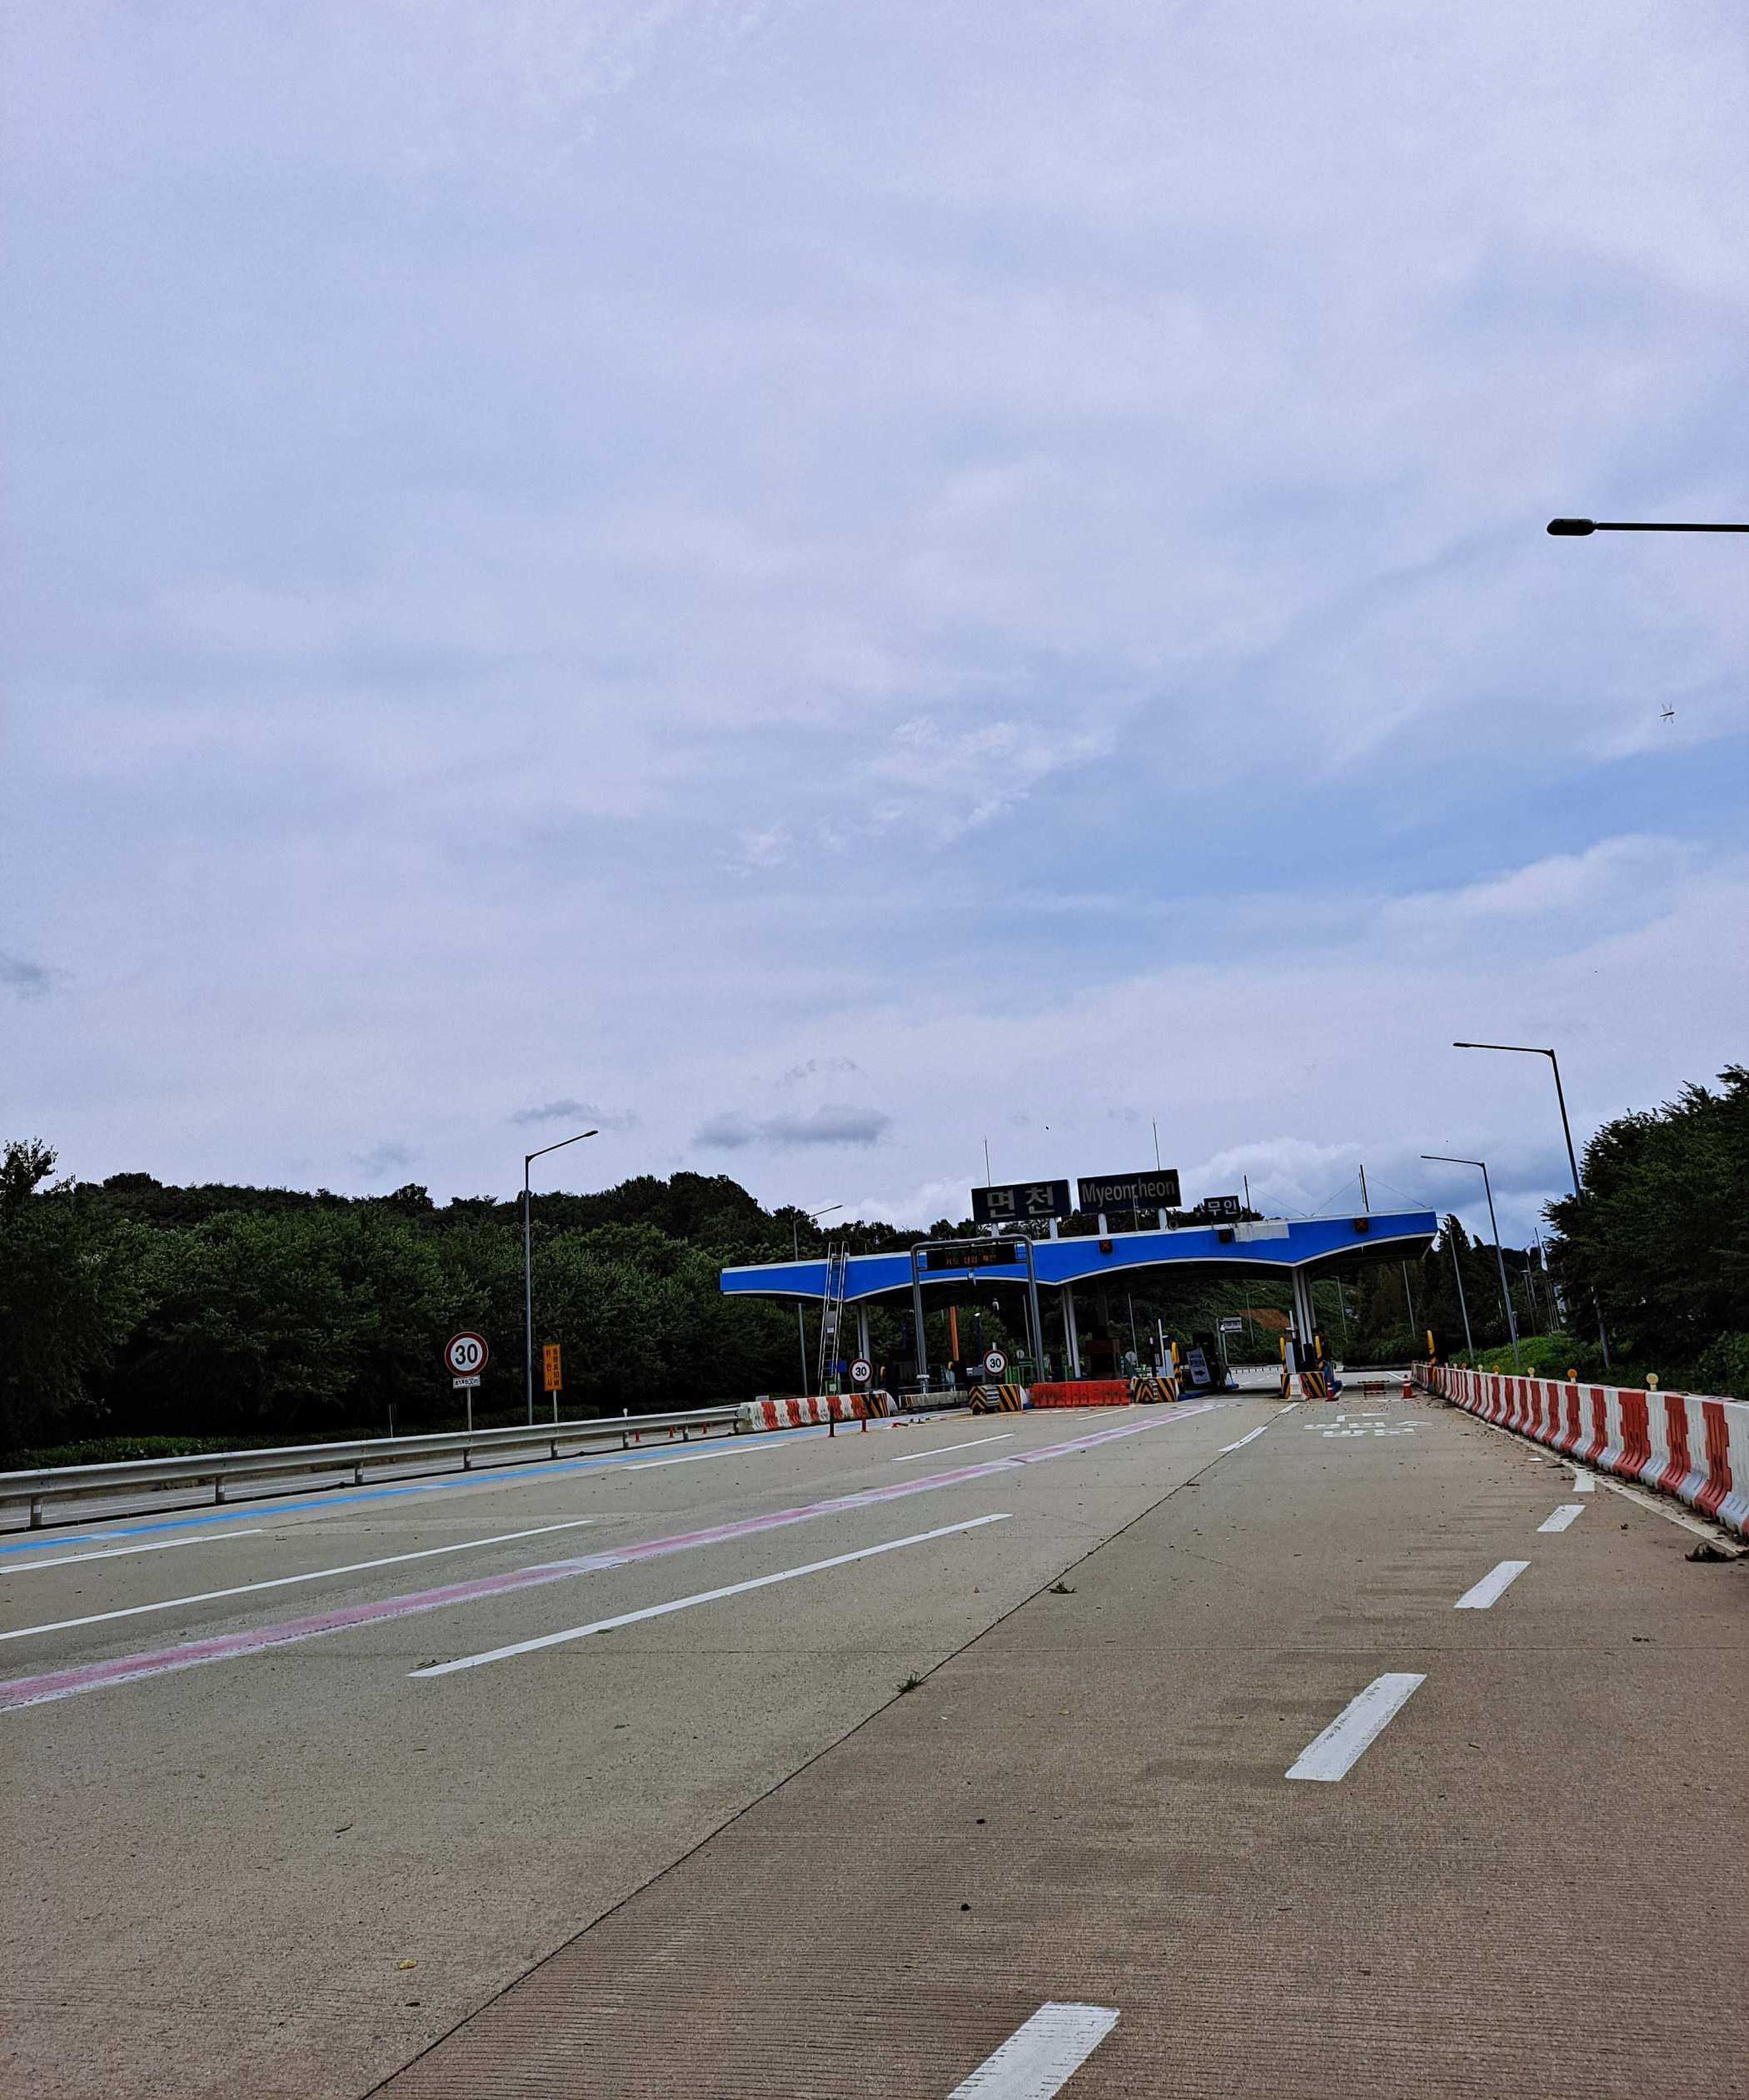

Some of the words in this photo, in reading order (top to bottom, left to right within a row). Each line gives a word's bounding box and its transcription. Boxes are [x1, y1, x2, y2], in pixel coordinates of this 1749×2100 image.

[987, 1185, 1055, 1218] 면천
[1082, 1177, 1176, 1207] Myeoncheon
[1207, 1199, 1238, 1217] 무인
[455, 1343, 478, 1365] 30
[989, 1357, 1002, 1368] 30
[855, 1366, 867, 1376] 30
